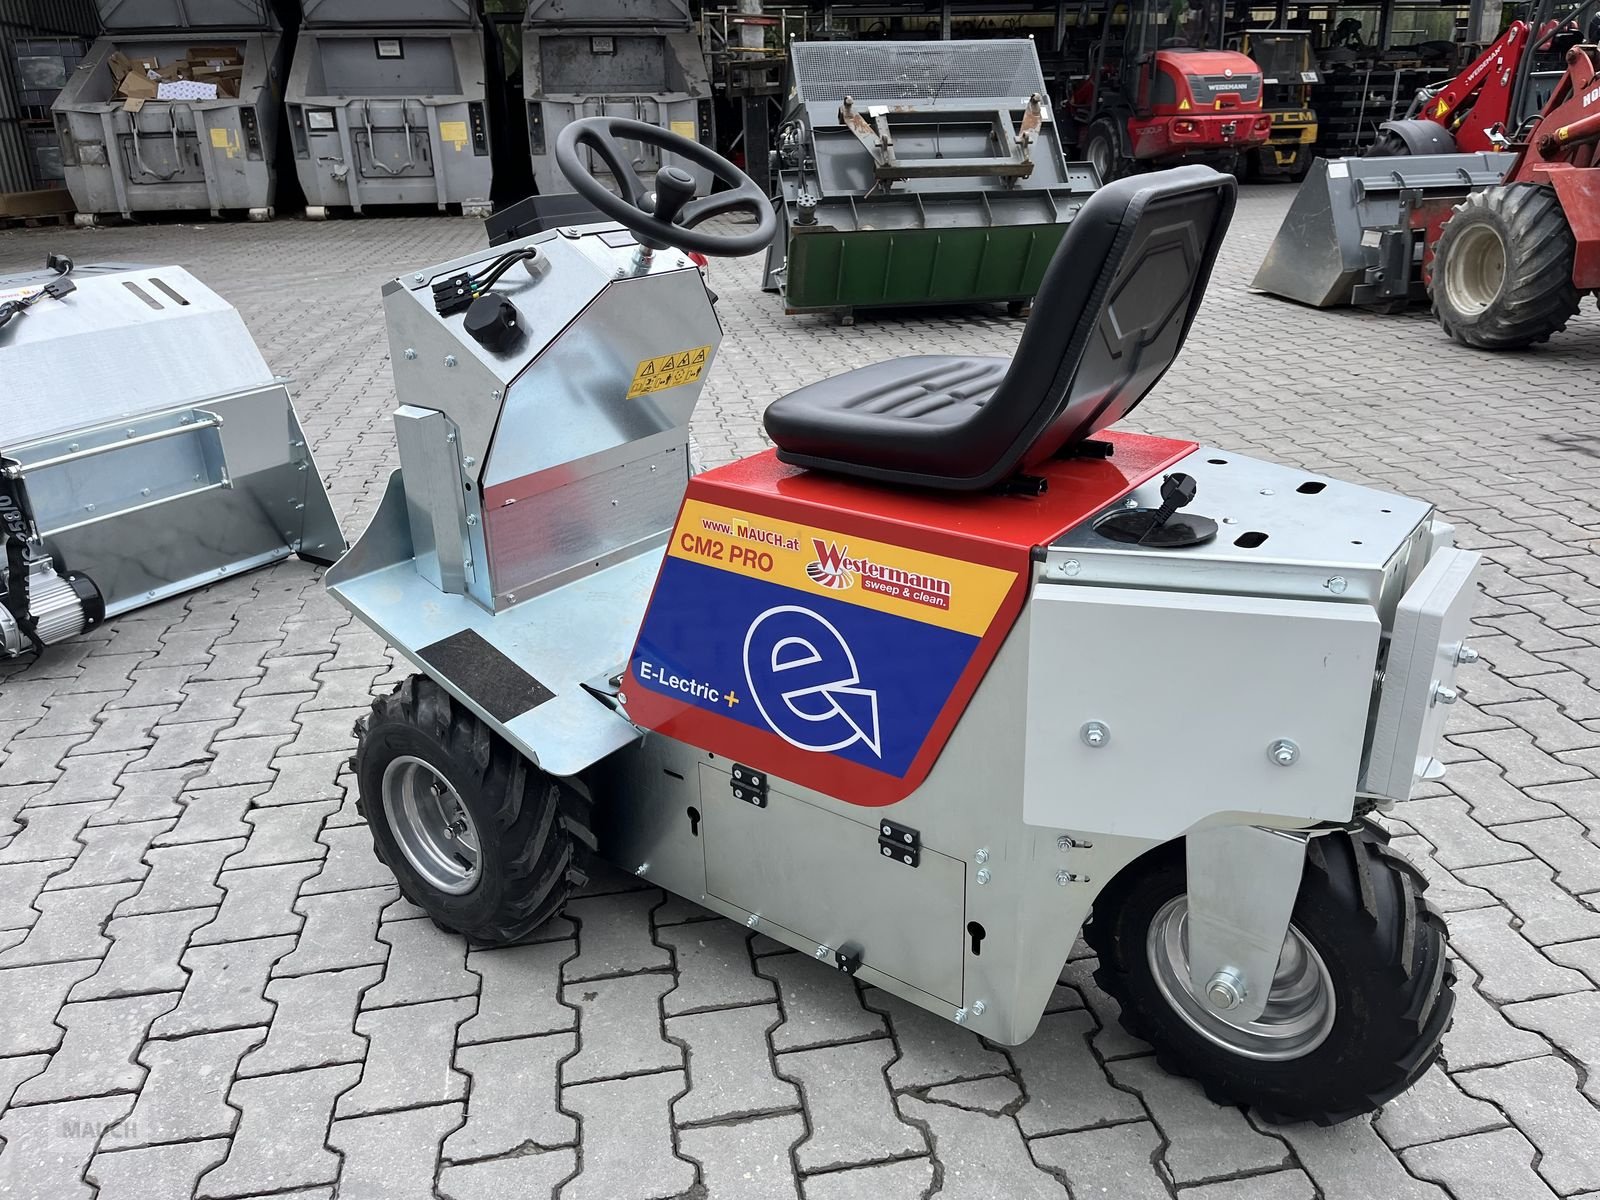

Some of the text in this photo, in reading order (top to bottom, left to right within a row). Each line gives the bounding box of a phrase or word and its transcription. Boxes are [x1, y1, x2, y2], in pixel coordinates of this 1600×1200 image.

[1208, 83, 1247, 91] WEIDEMANN
[1271, 112, 1312, 121] TCM
[680, 532, 774, 573] CM2 PRO
[811, 538, 951, 594] Westermann
[864, 579, 947, 608] sweep & clean.
[640, 661, 720, 703] E-Lectric
